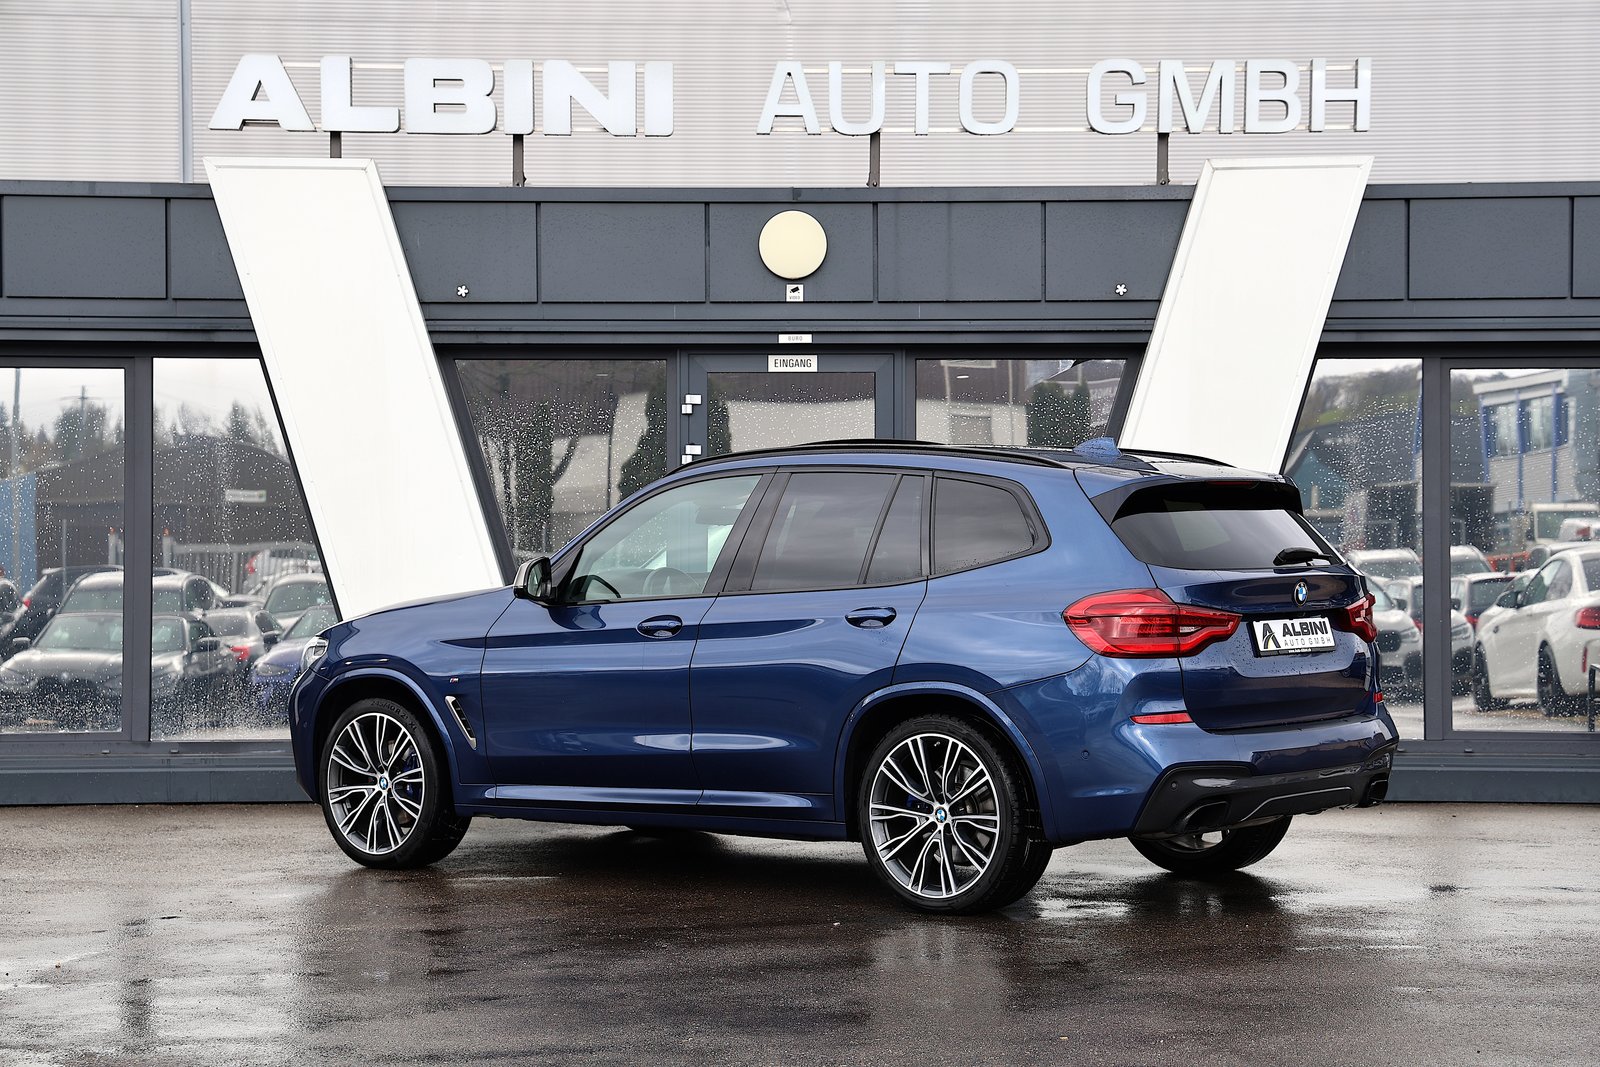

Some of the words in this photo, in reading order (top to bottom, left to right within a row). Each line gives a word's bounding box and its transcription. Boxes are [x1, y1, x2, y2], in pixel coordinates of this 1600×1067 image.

[208, 54, 674, 137] ALBINI
[757, 60, 1020, 136] AUTO
[1086, 57, 1373, 134] GMBH
[774, 358, 812, 368] EINGANG
[1282, 621, 1328, 637] ALBINI
[1284, 637, 1306, 647] AUTO
[1308, 636, 1332, 645] GMBH
